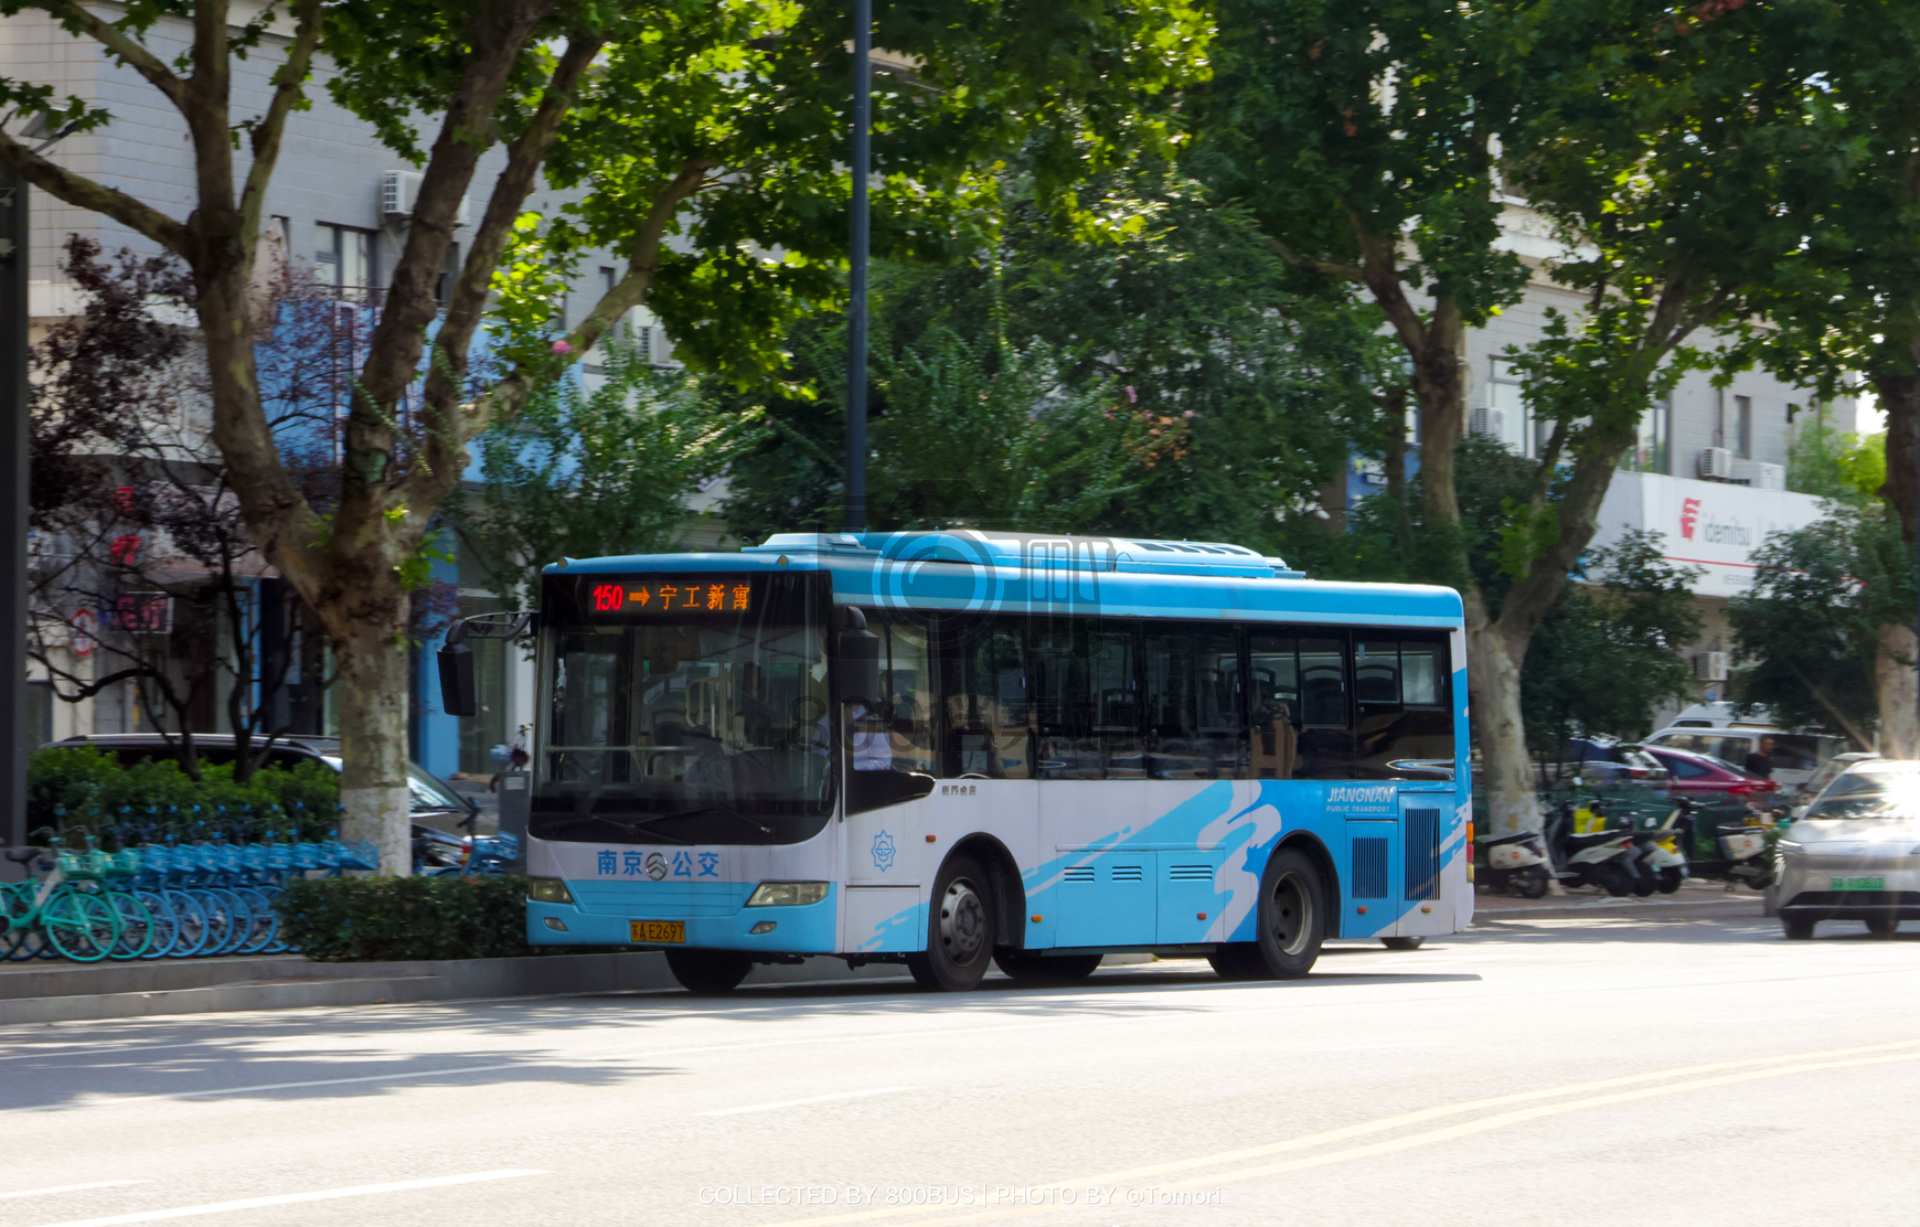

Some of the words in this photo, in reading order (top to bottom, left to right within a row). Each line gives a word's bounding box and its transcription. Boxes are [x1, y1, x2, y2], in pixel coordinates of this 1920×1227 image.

[593, 584, 624, 611] 150
[659, 584, 750, 610] 宁工新寓
[1327, 786, 1394, 803] JIANGNAN
[597, 849, 643, 876] 南京
[672, 851, 719, 877] 公交
